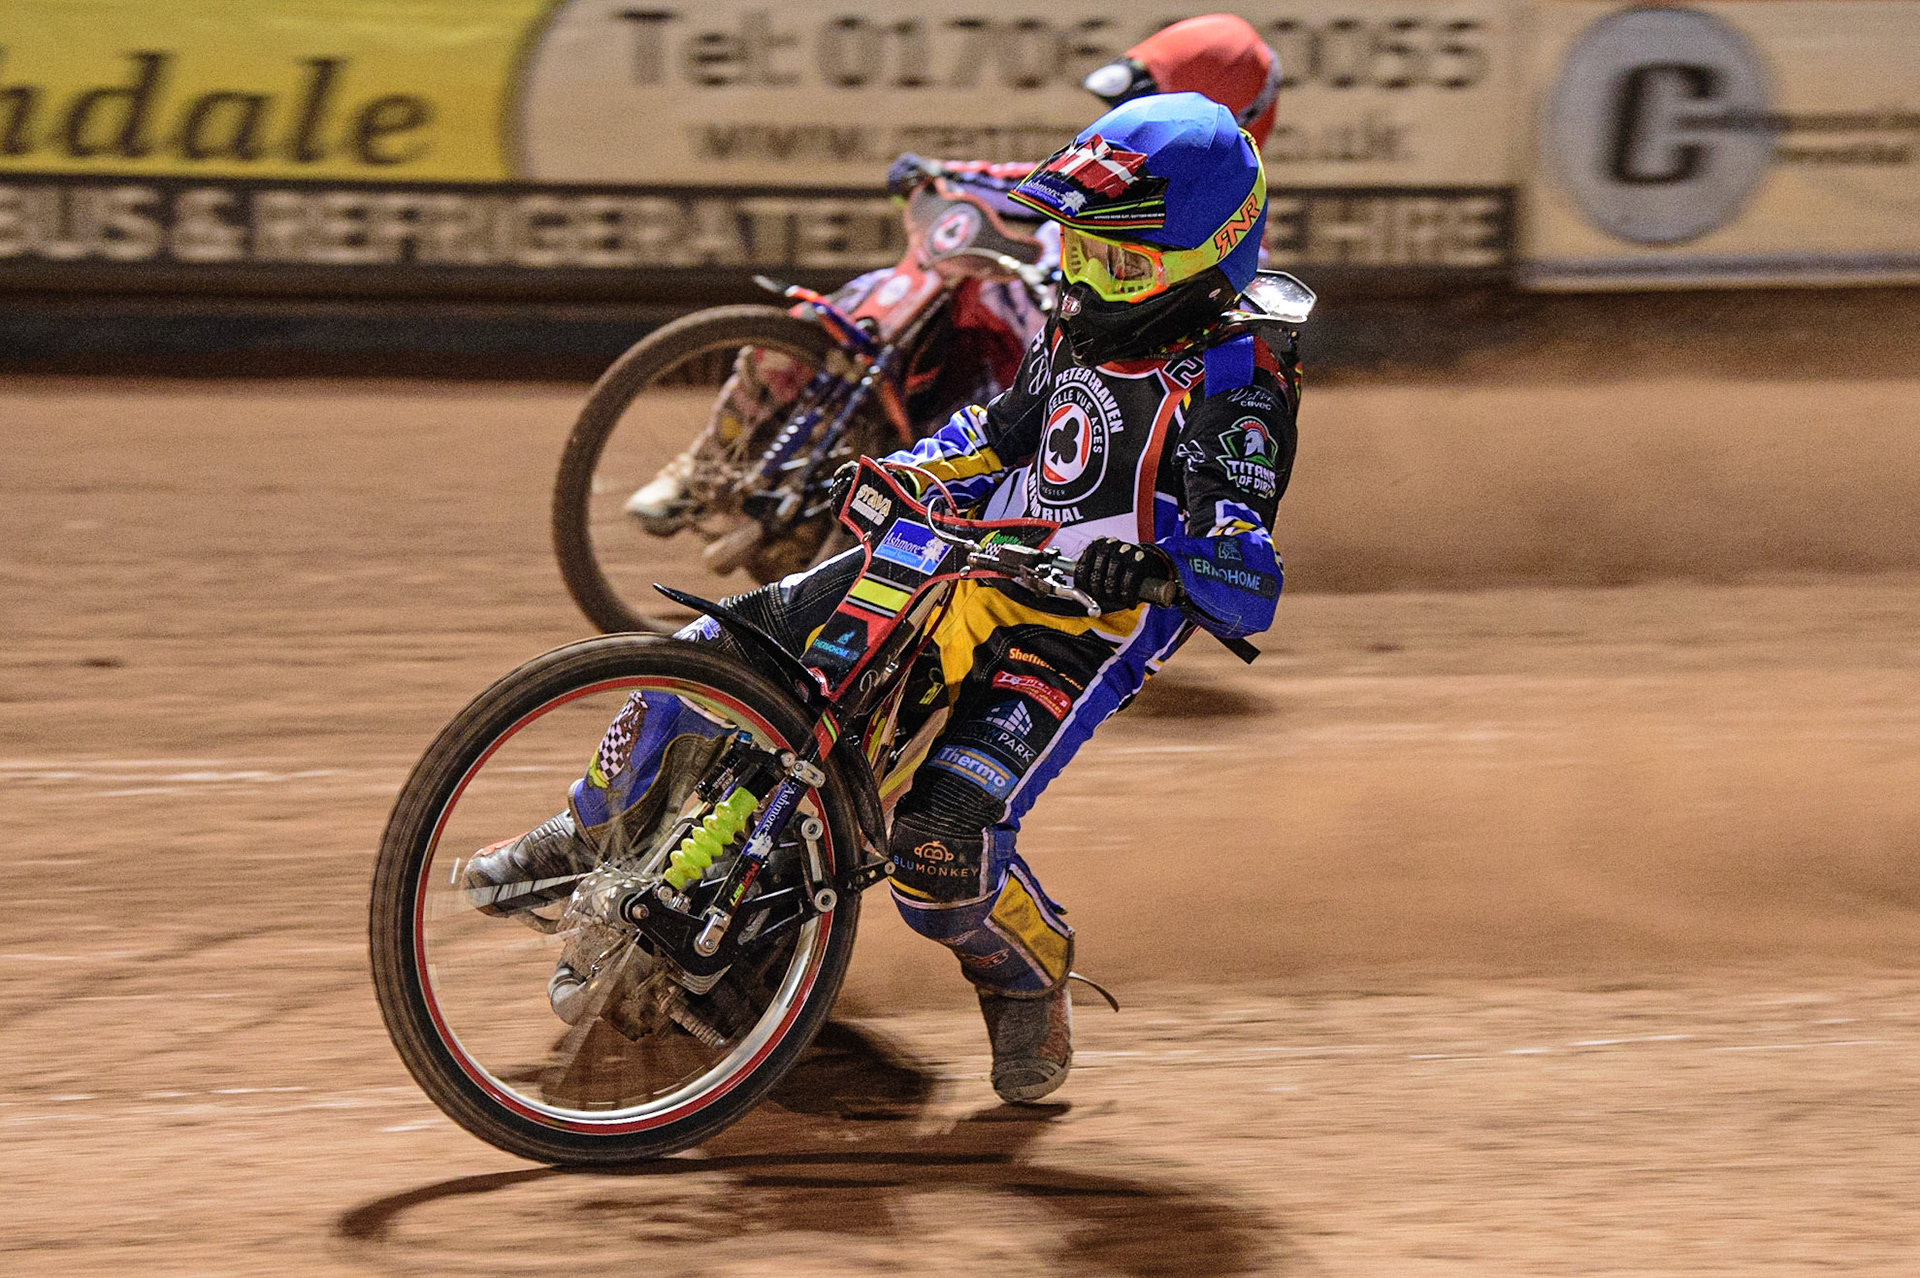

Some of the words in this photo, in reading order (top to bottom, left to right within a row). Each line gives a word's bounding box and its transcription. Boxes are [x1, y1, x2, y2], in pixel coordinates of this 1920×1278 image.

[1055, 367, 1092, 389] PETER
[1087, 372, 1125, 434] CRAVEN
[1076, 390, 1094, 413] VUE
[1090, 416, 1104, 454] ACES
[1238, 474, 1252, 487] OF
[883, 531, 921, 554] Ashmore
[939, 747, 1007, 788] Thermo
[763, 781, 796, 833] Ashmore
[893, 854, 980, 878] BLUMONKEY
